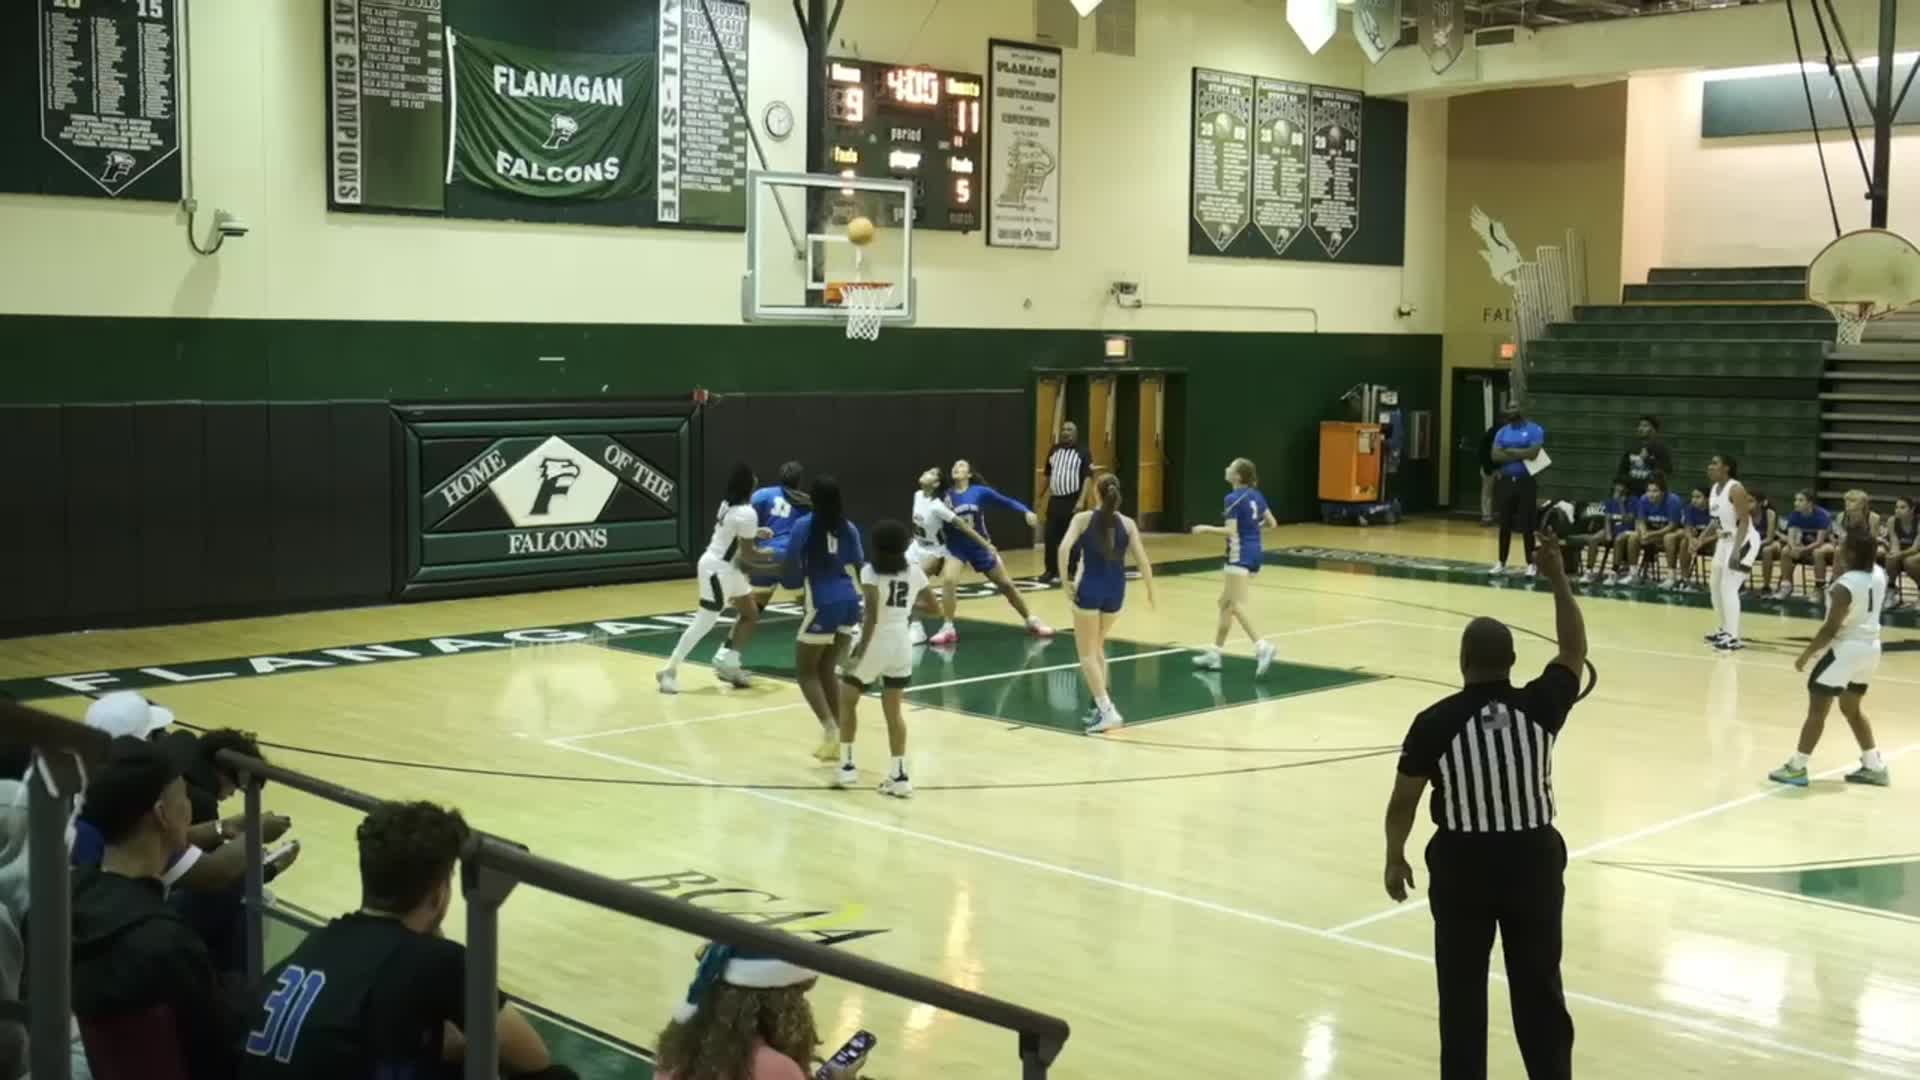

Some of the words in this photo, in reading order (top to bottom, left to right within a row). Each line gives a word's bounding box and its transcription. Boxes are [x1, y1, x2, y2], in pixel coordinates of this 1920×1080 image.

[494, 65, 623, 107] FLANAGAN
[661, 20, 678, 220] ALL-STATE
[846, 87, 864, 122] 9
[957, 100, 979, 133] 11
[335, 54, 359, 199] CHAMPIONS
[496, 150, 620, 183] FALCONS
[955, 179, 970, 203] 5
[440, 450, 507, 507] HOME
[603, 444, 632, 473] OF
[632, 463, 675, 502] THE
[508, 528, 608, 554] FALCONS
[886, 580, 910, 607] 12
[1867, 587, 1873, 613] 1
[245, 965, 326, 1064] 31
